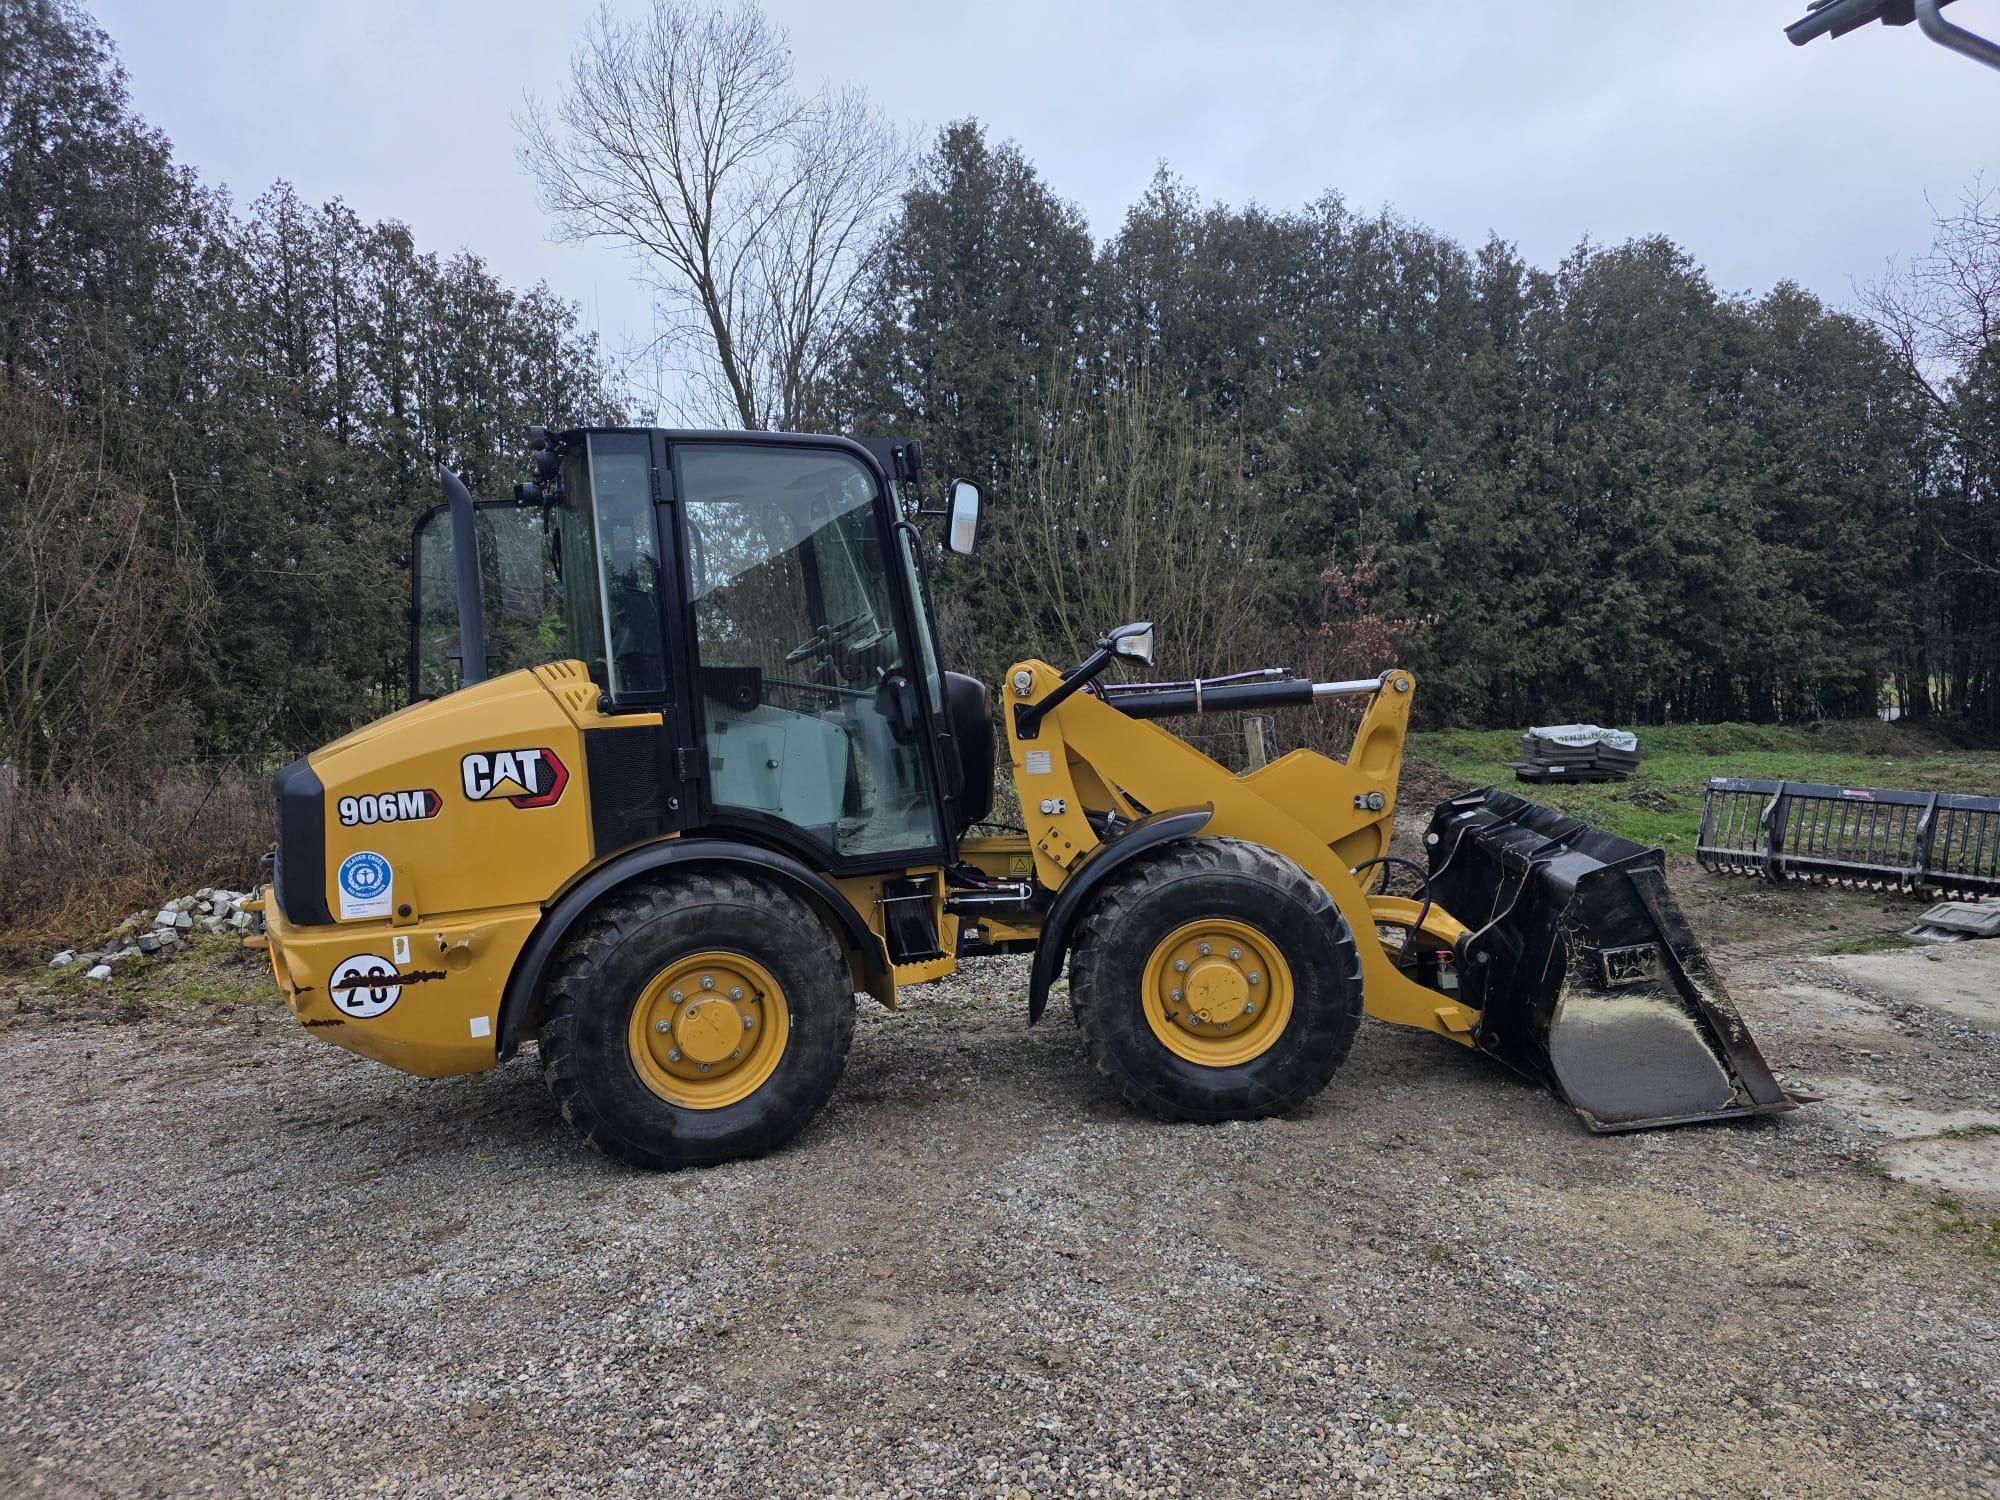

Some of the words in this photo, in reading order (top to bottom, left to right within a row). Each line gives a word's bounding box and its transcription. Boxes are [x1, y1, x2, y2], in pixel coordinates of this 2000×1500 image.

[462, 749, 542, 800] CAT
[340, 790, 426, 826] 906M
[345, 854, 367, 868] BLAUER
[367, 854, 385, 866] ENGEL
